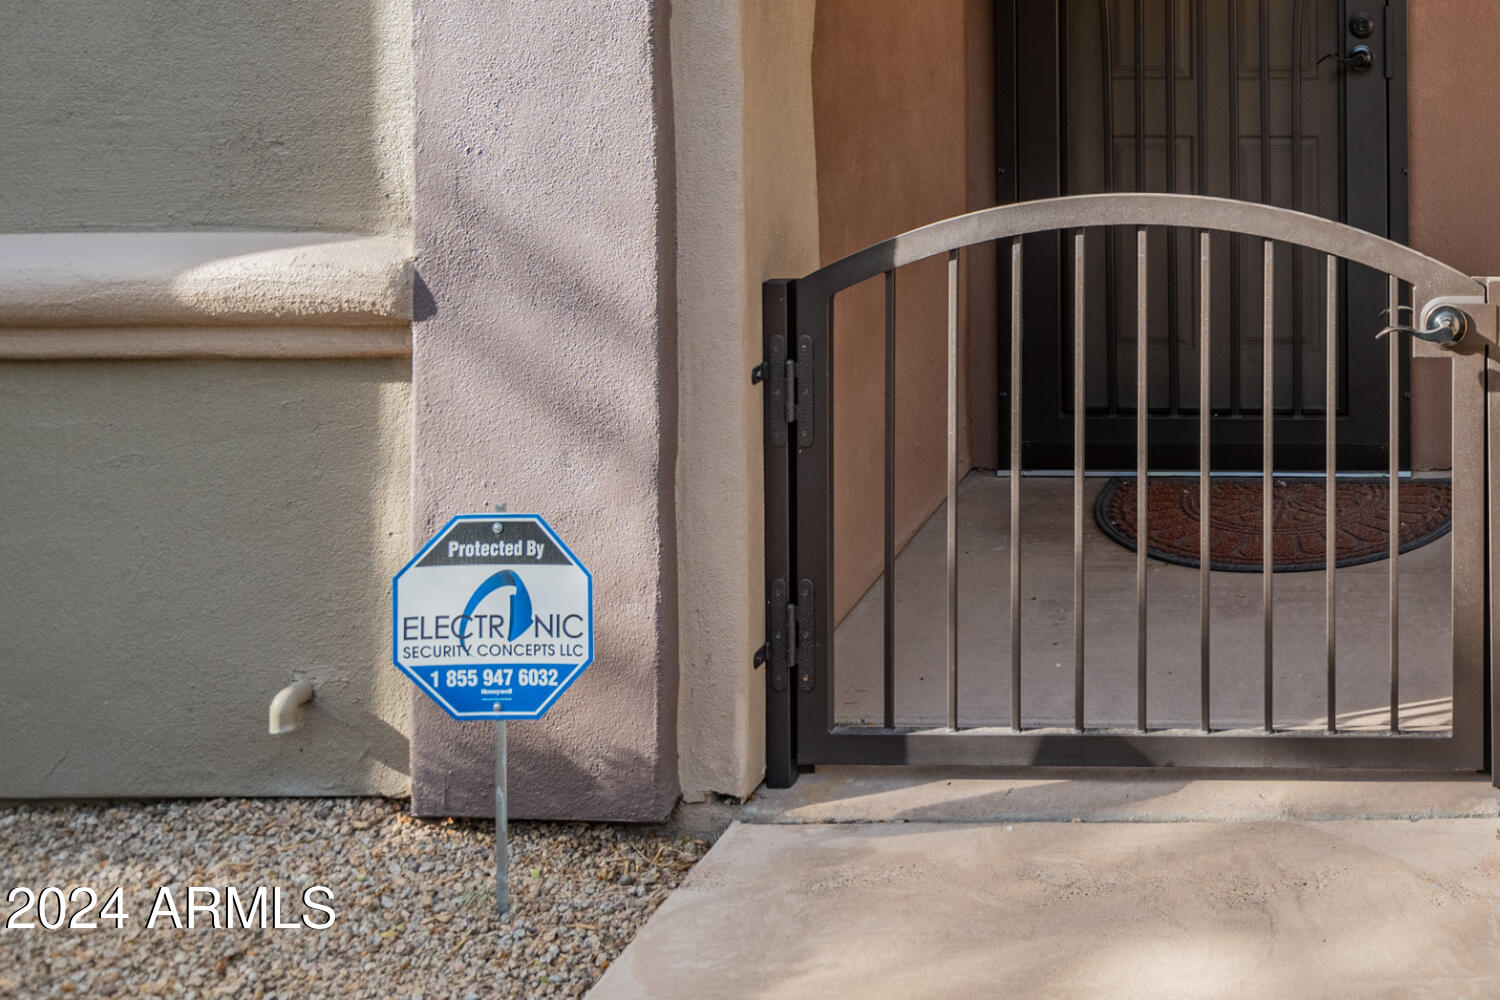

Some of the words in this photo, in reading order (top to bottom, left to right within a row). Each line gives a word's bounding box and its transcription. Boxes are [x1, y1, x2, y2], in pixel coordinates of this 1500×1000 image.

[449, 541, 522, 557] Protected
[526, 540, 545, 559] By
[403, 645, 472, 659] SECURITY
[477, 644, 555, 657] CONCEPTS
[560, 644, 583, 656] LLC
[430, 671, 440, 687] 1
[446, 669, 478, 687] 855
[483, 669, 513, 686] 947
[518, 669, 559, 687] 6032
